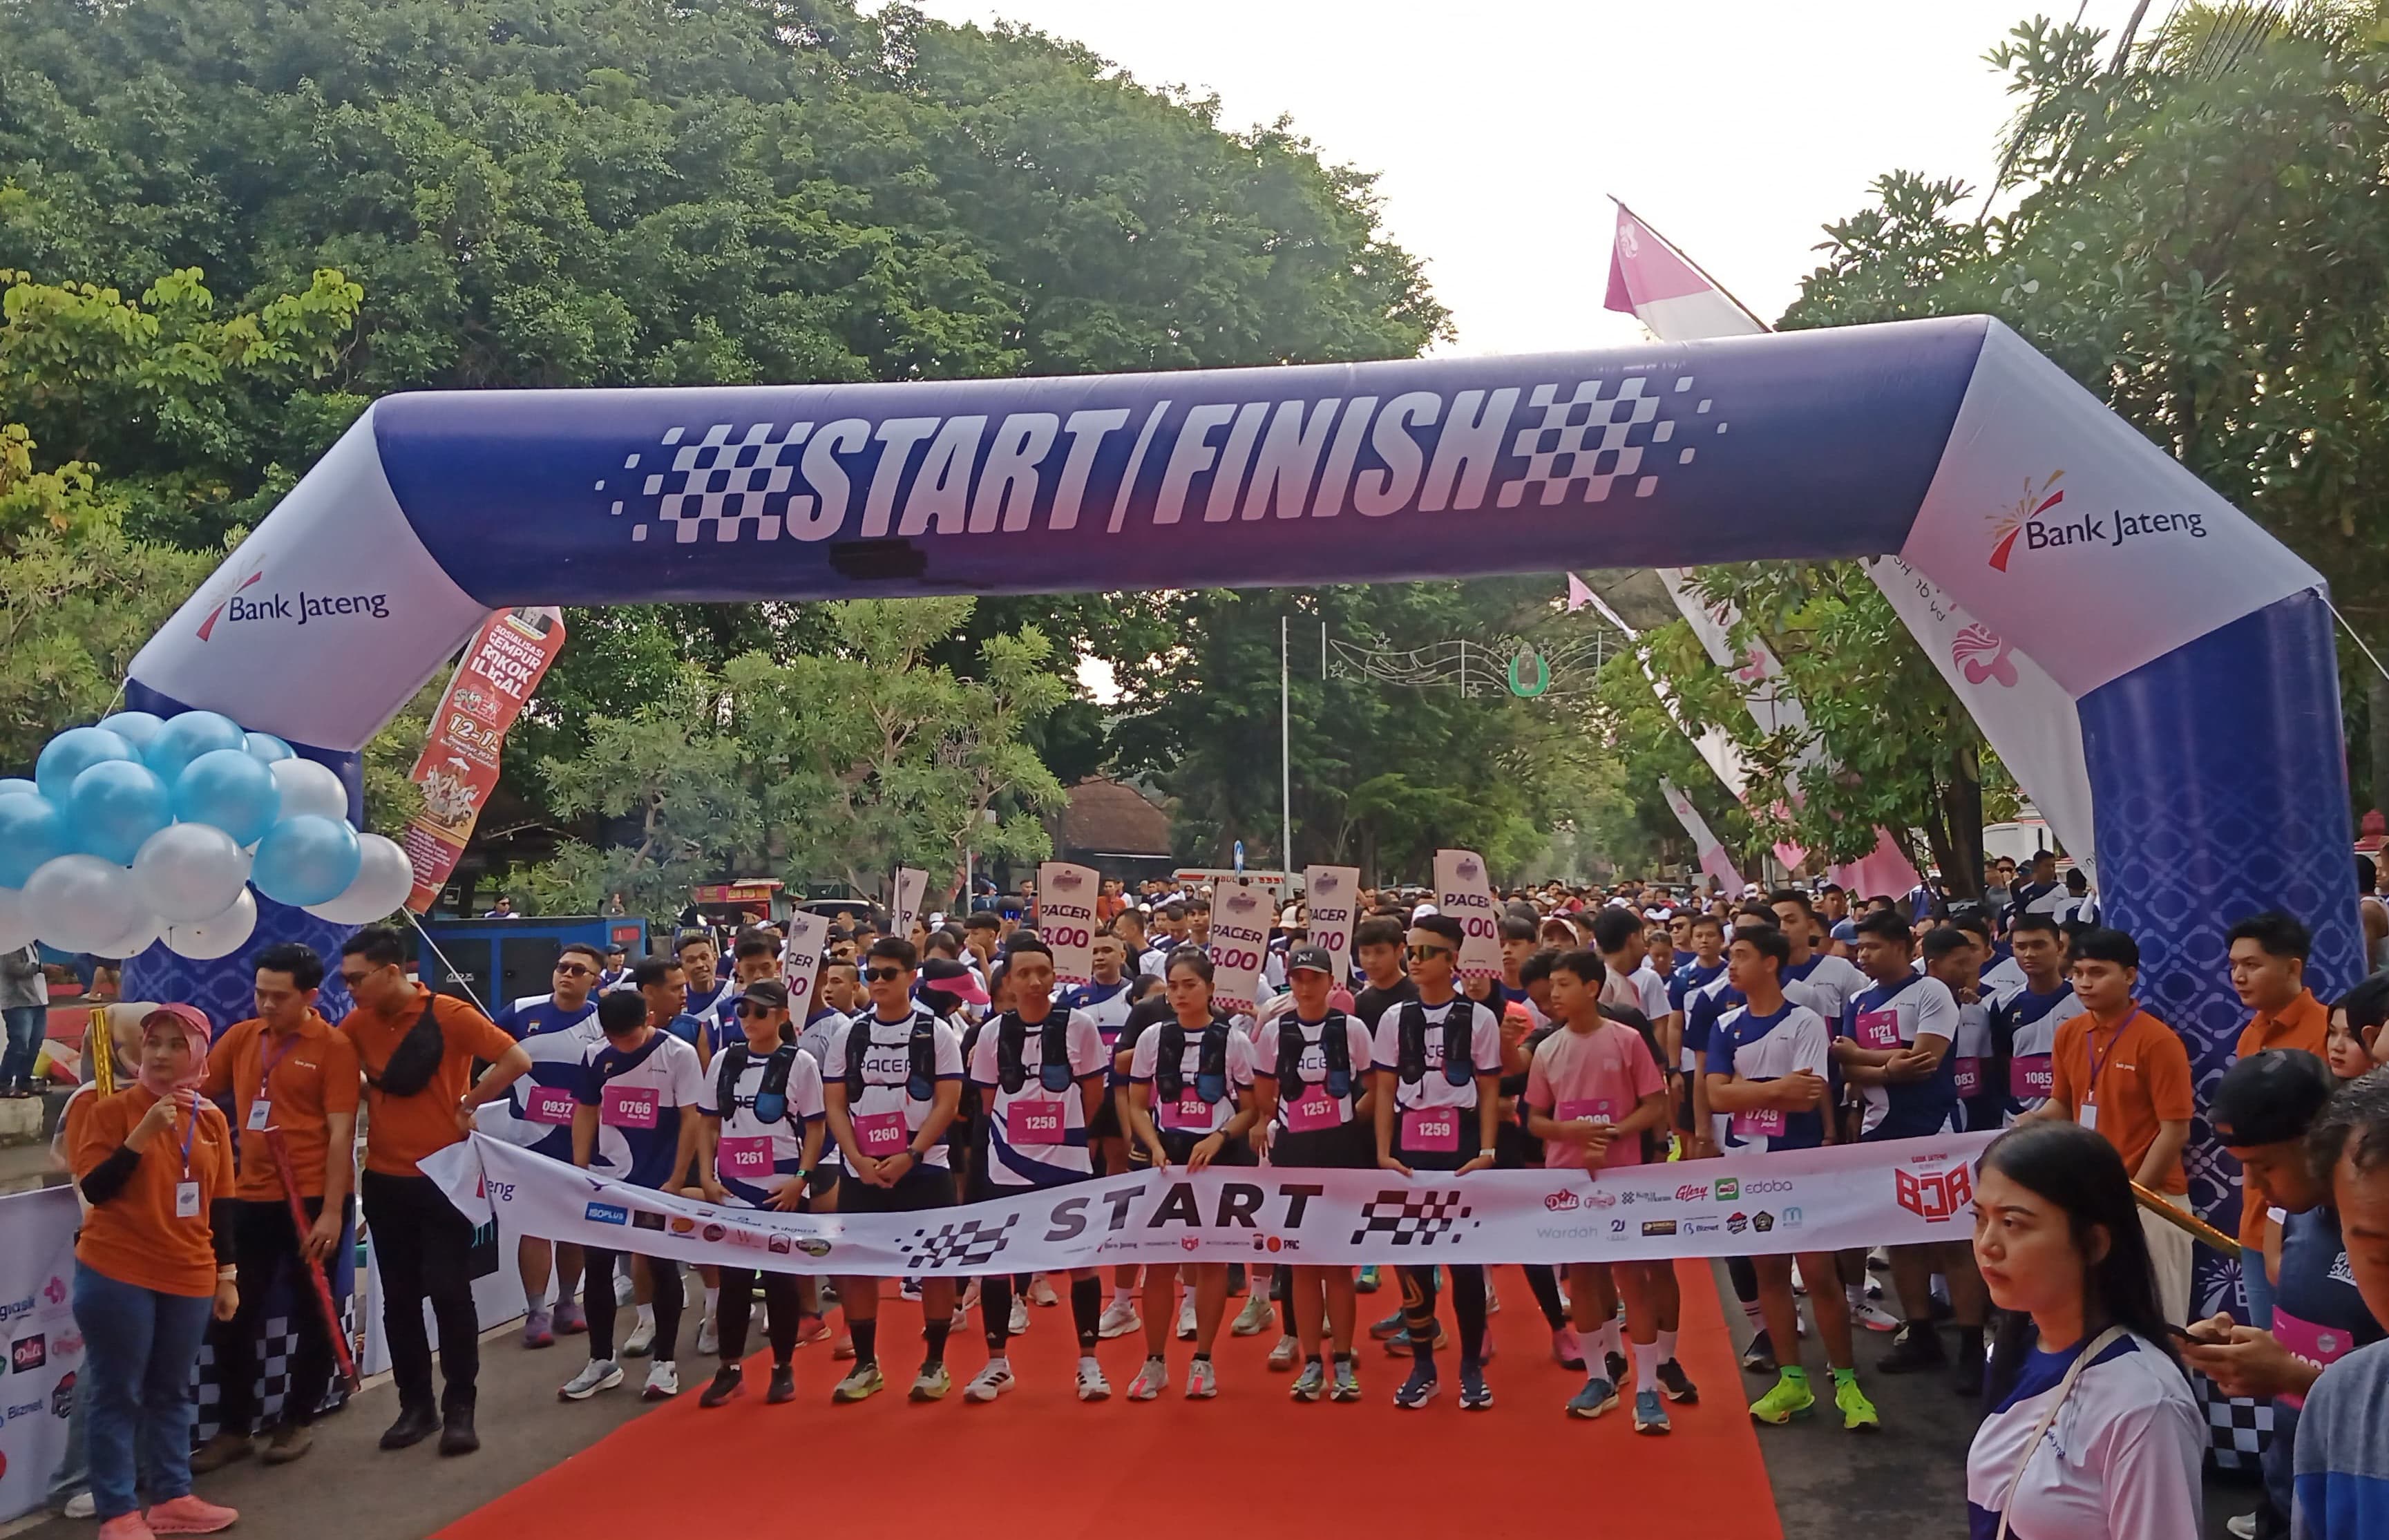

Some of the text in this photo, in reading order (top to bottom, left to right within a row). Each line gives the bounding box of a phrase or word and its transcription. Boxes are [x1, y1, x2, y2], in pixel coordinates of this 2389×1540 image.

[2026, 510, 2207, 550] Bank Jateng
[229, 591, 390, 625] Bank Jateng
[494, 624, 546, 658] SOSIALISASI
[488, 631, 542, 670] GEMPUR
[789, 953, 813, 968] CER
[1869, 1024, 1892, 1039] 1121
[1954, 1072, 1976, 1086] 083
[2025, 1072, 2053, 1084] 1085
[542, 1100, 573, 1114] 0937
[620, 1101, 651, 1114] 0766
[1302, 1101, 1331, 1116] 1257
[1025, 1116, 1057, 1130] 1258
[1418, 1122, 1450, 1137] 1259
[868, 1127, 899, 1143] 1260
[734, 1151, 763, 1164] 1261
[1043, 1181, 1324, 1242] START
[1537, 1226, 1598, 1239] Wardah
